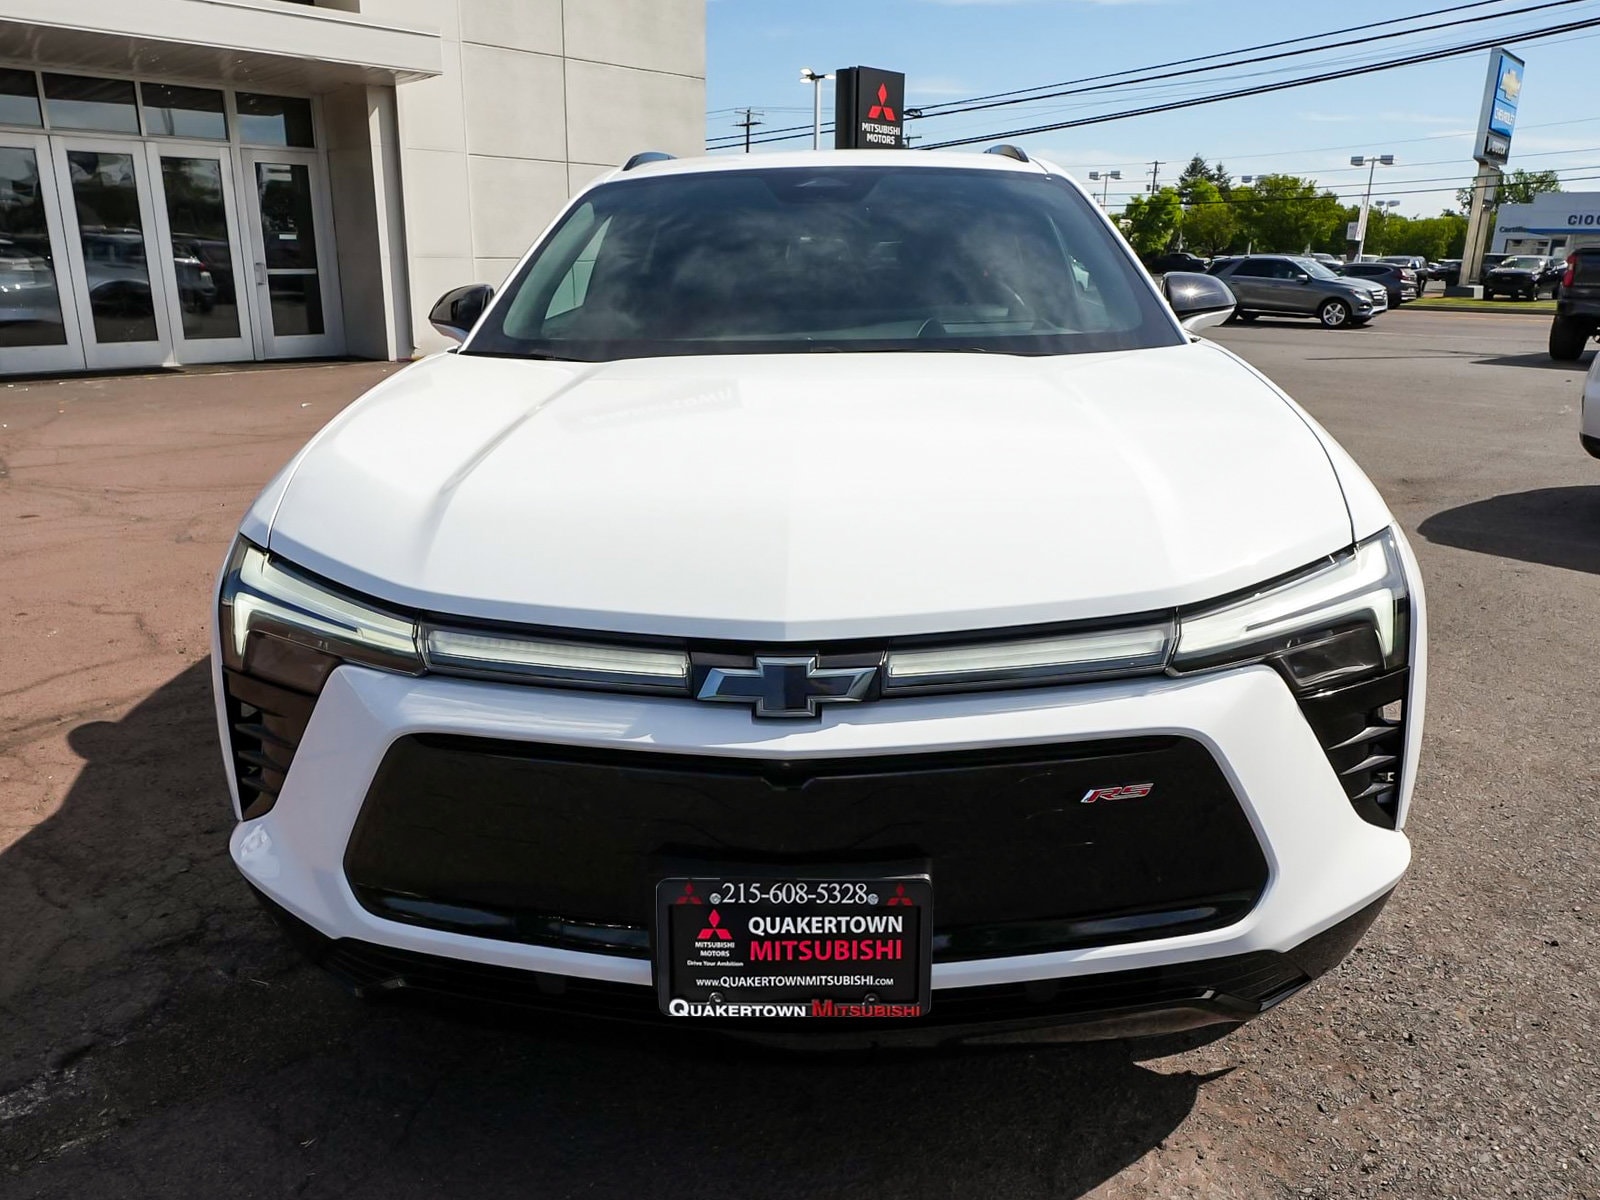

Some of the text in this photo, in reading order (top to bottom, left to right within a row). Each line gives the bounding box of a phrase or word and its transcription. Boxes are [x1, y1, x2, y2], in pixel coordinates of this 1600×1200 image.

[861, 122, 901, 135] MITSUBISHI
[866, 133, 896, 145] MOTORS
[1080, 783, 1154, 803] RS
[721, 883, 868, 905] 215-608-5328
[748, 915, 904, 936] QUAKERTOWN
[694, 941, 735, 949] MITSUBISHI
[749, 940, 903, 961] MITSUBISHI
